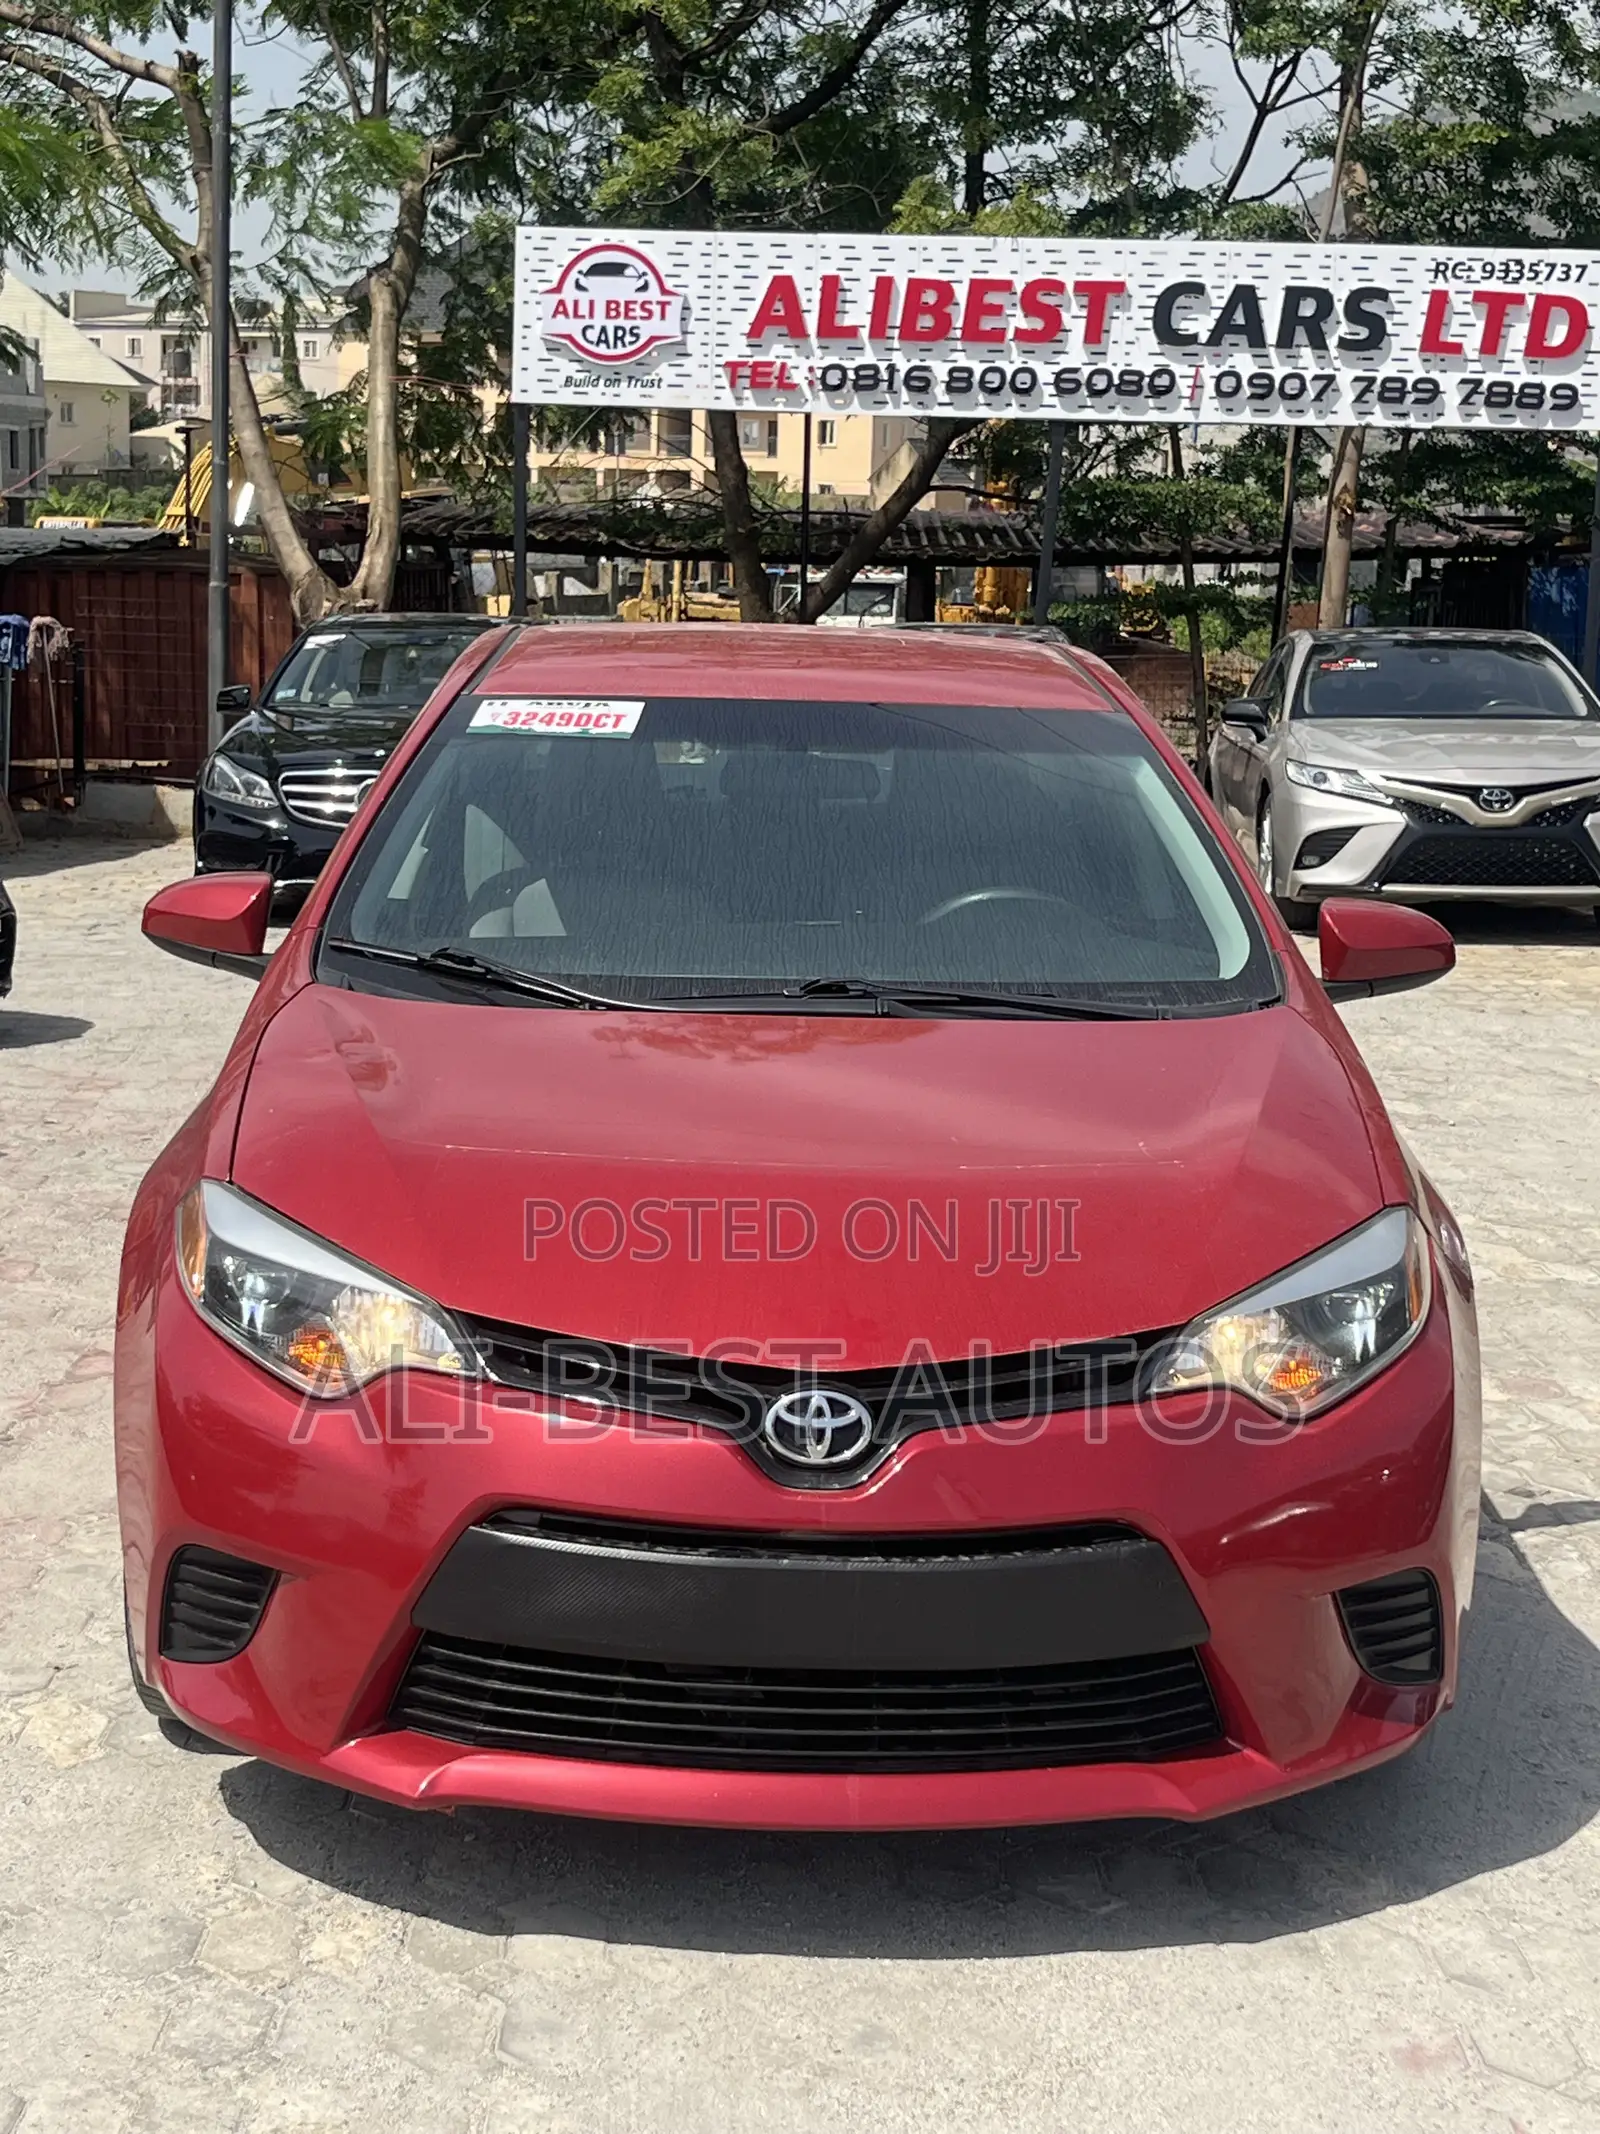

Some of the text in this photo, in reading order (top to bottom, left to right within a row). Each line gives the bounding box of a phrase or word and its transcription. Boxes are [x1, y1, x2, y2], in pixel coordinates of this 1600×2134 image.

[1480, 262, 1588, 283] 9335737
[551, 299, 671, 321] ALI BEST
[747, 275, 1589, 359] ALIBEST CARS LTD
[581, 324, 641, 350] CARS
[563, 375, 664, 389] Build on Trust
[820, 363, 933, 394] 0816
[944, 365, 1038, 395] 800
[1053, 367, 1176, 398] 6080
[1213, 370, 1337, 402] 0907
[1350, 376, 1441, 408] 789
[1456, 378, 1580, 412] 7889
